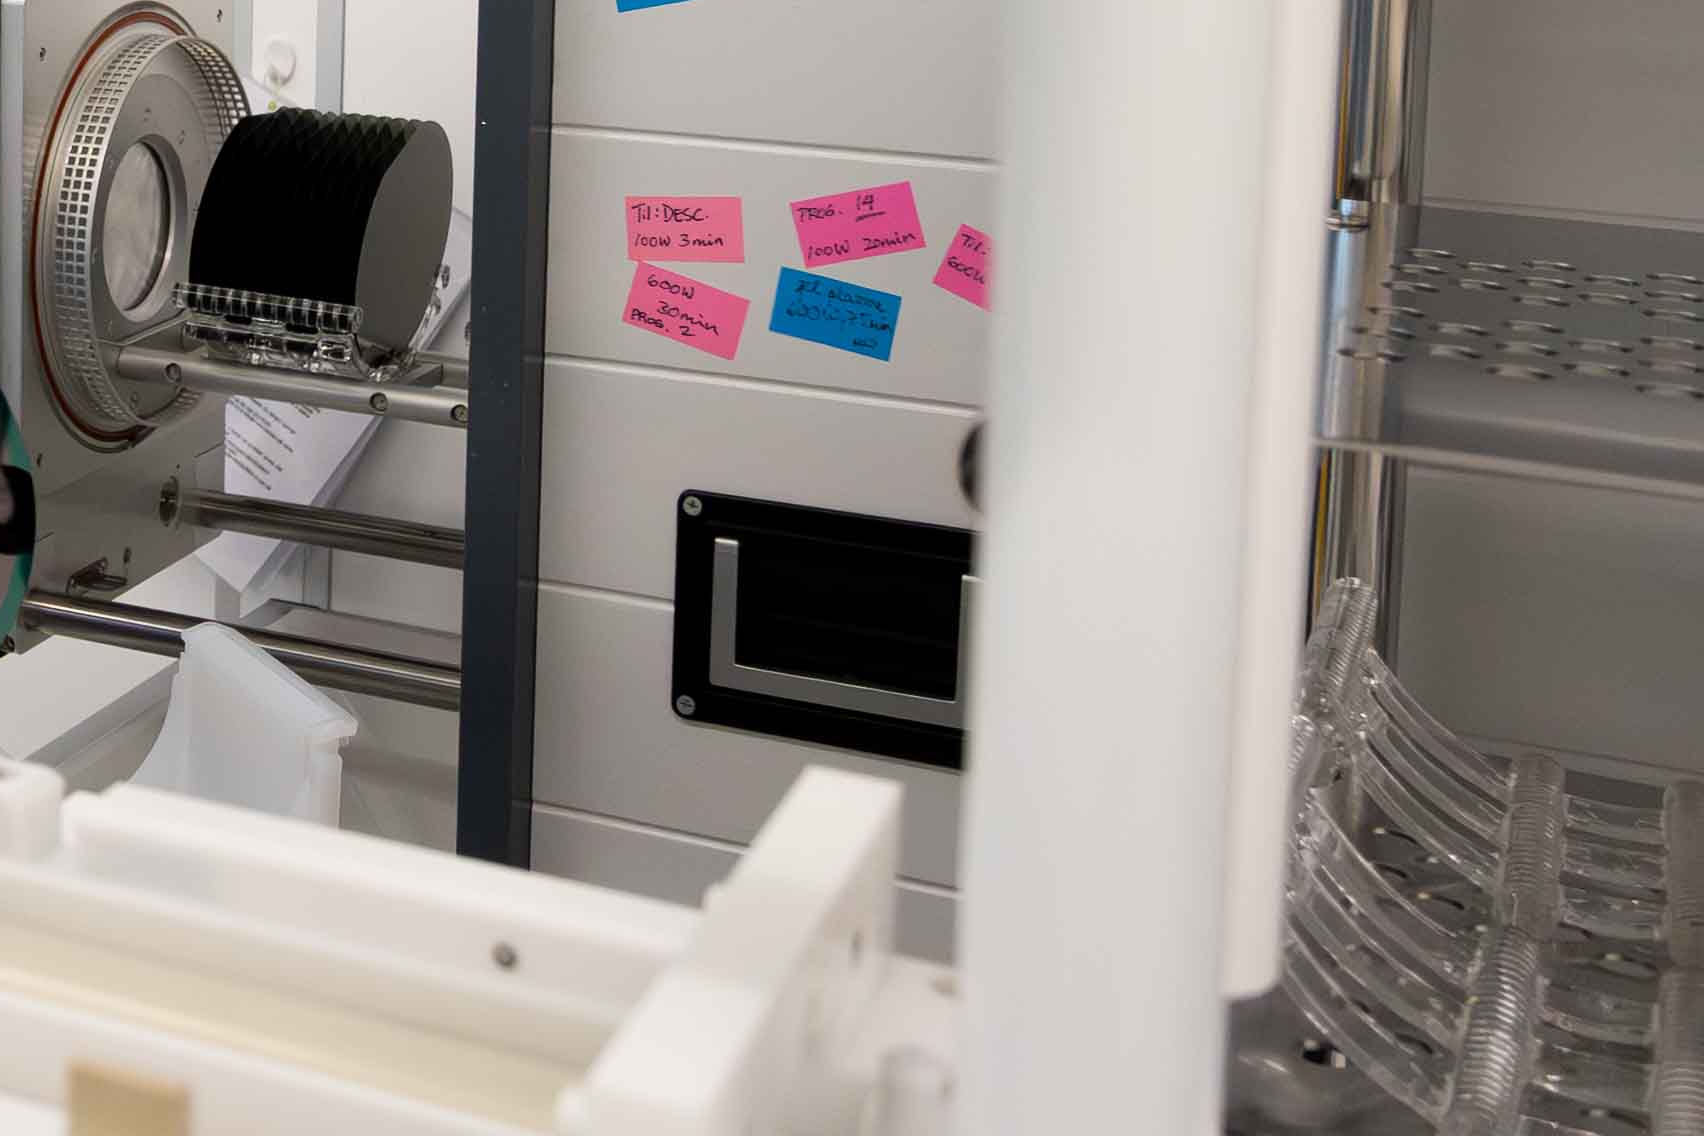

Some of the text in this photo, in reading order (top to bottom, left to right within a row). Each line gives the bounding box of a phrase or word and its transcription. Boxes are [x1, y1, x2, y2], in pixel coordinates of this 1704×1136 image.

[634, 233, 671, 247] 100W
[807, 239, 850, 260] 100W
[647, 273, 695, 300] 600W
[656, 300, 720, 337] 30min
[679, 324, 697, 337] 2
